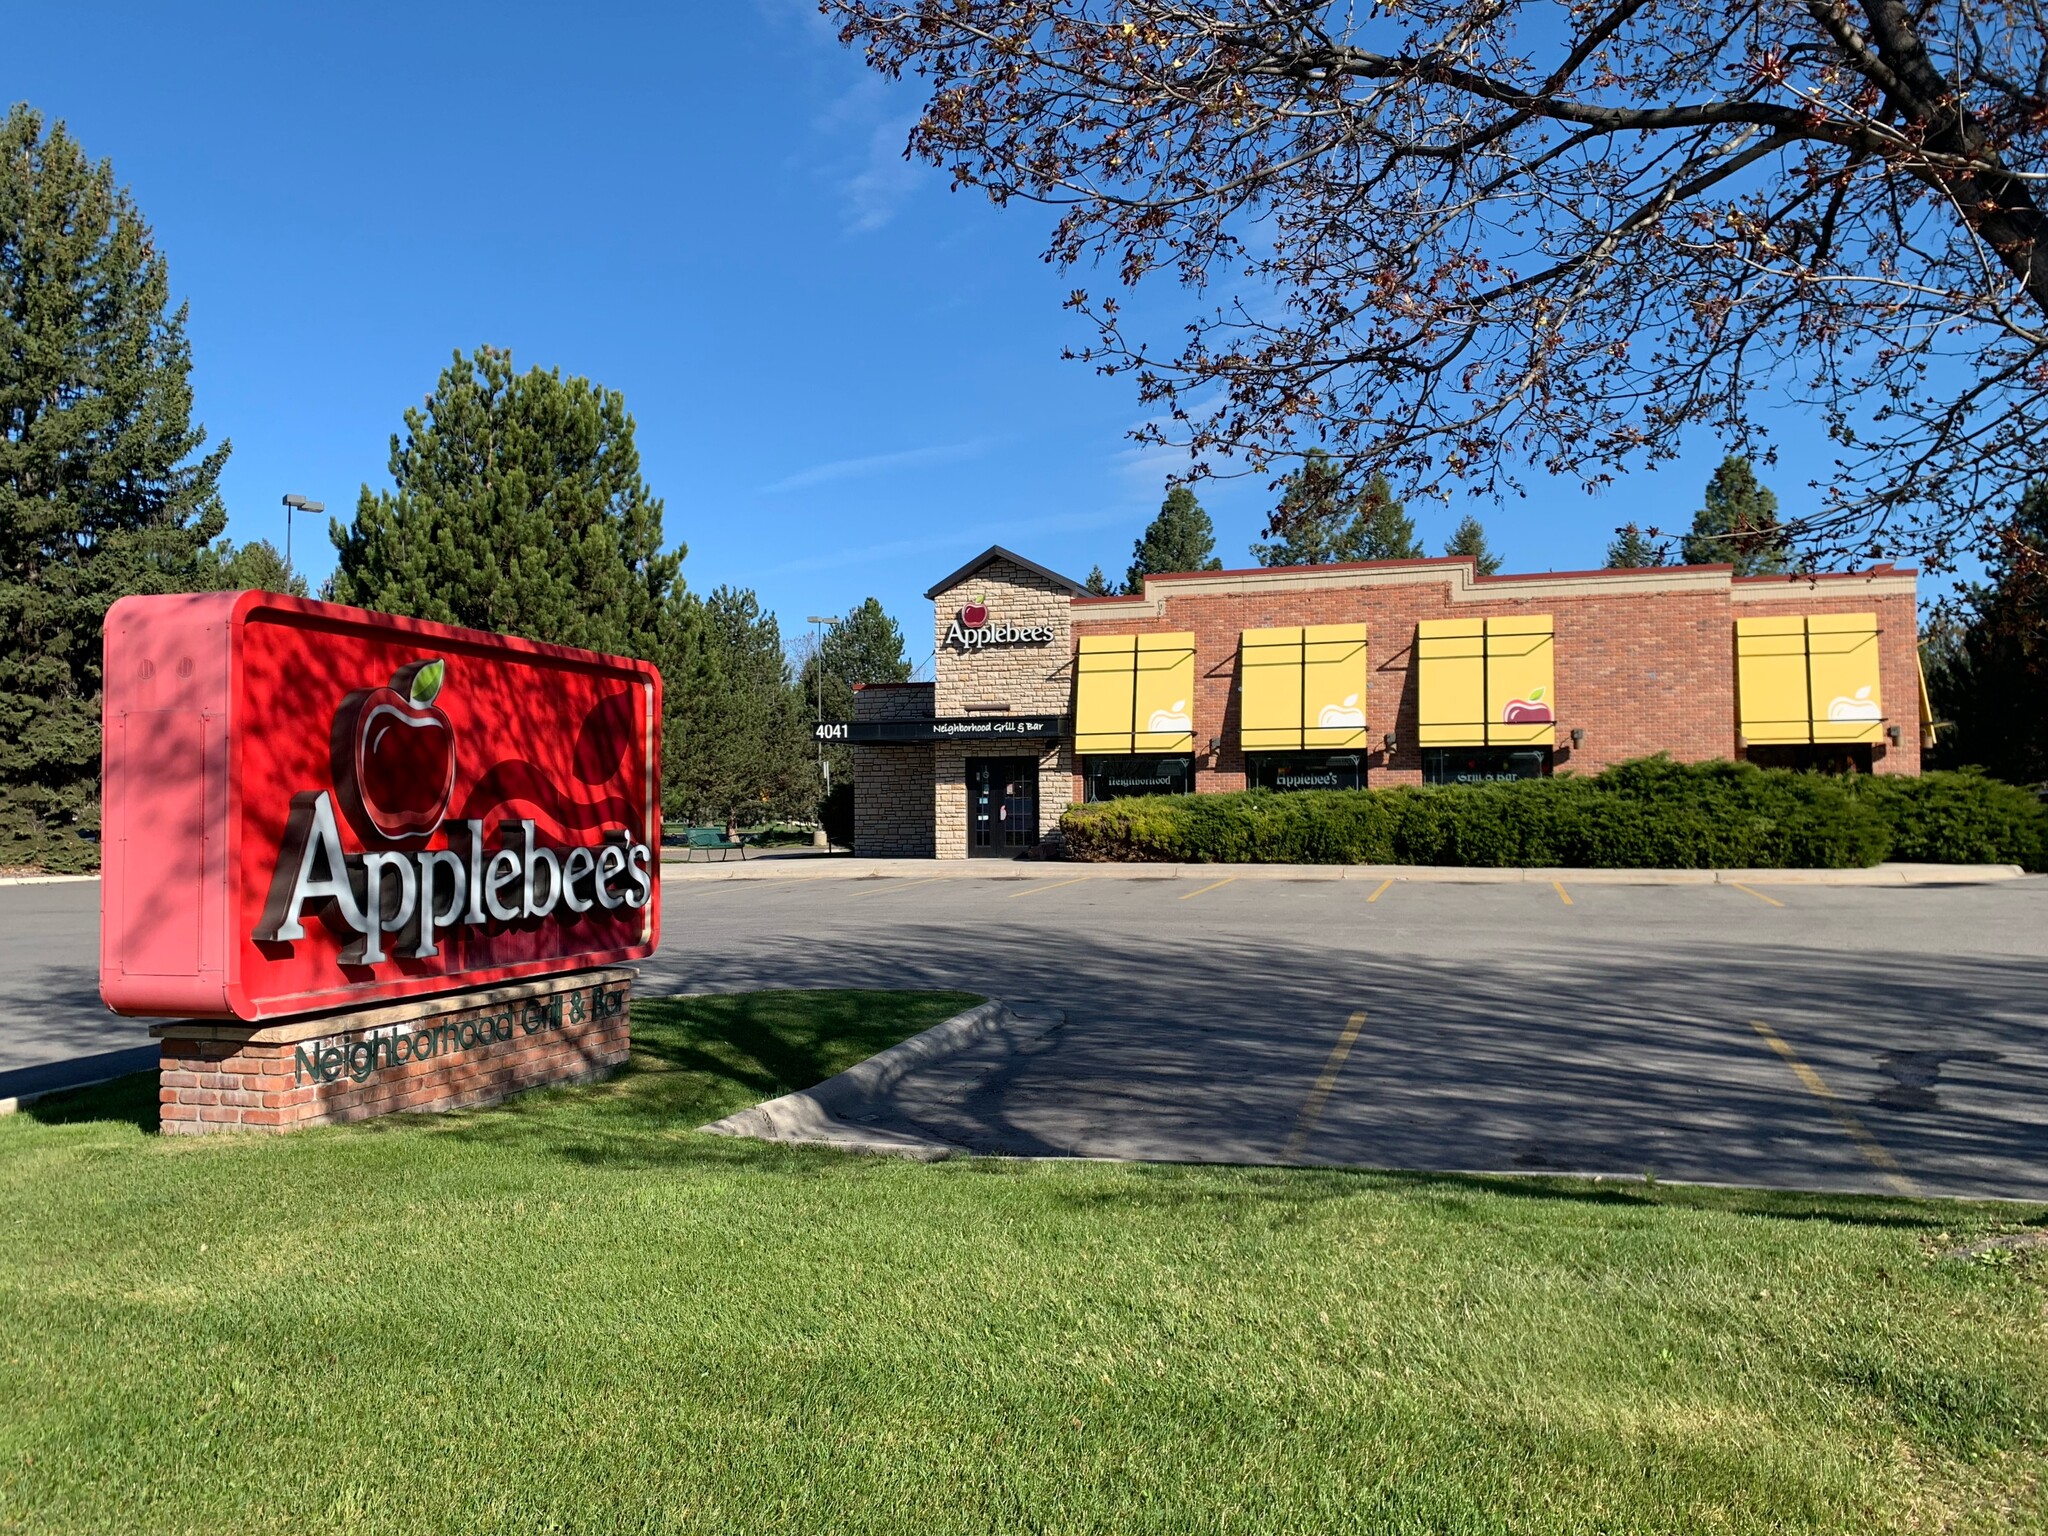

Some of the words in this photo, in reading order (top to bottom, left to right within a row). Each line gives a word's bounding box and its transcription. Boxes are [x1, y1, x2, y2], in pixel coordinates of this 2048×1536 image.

[816, 724, 848, 739] 4041
[933, 722, 992, 735] Neighborhood
[994, 721, 1016, 732] Grill
[1017, 722, 1025, 733] &
[1026, 722, 1043, 731] Bar
[276, 789, 652, 965] Applebee's
[295, 1003, 513, 1083] Neighborhood
[522, 995, 563, 1034] Grill
[570, 991, 586, 1024] &
[592, 987, 625, 1021] Bar
